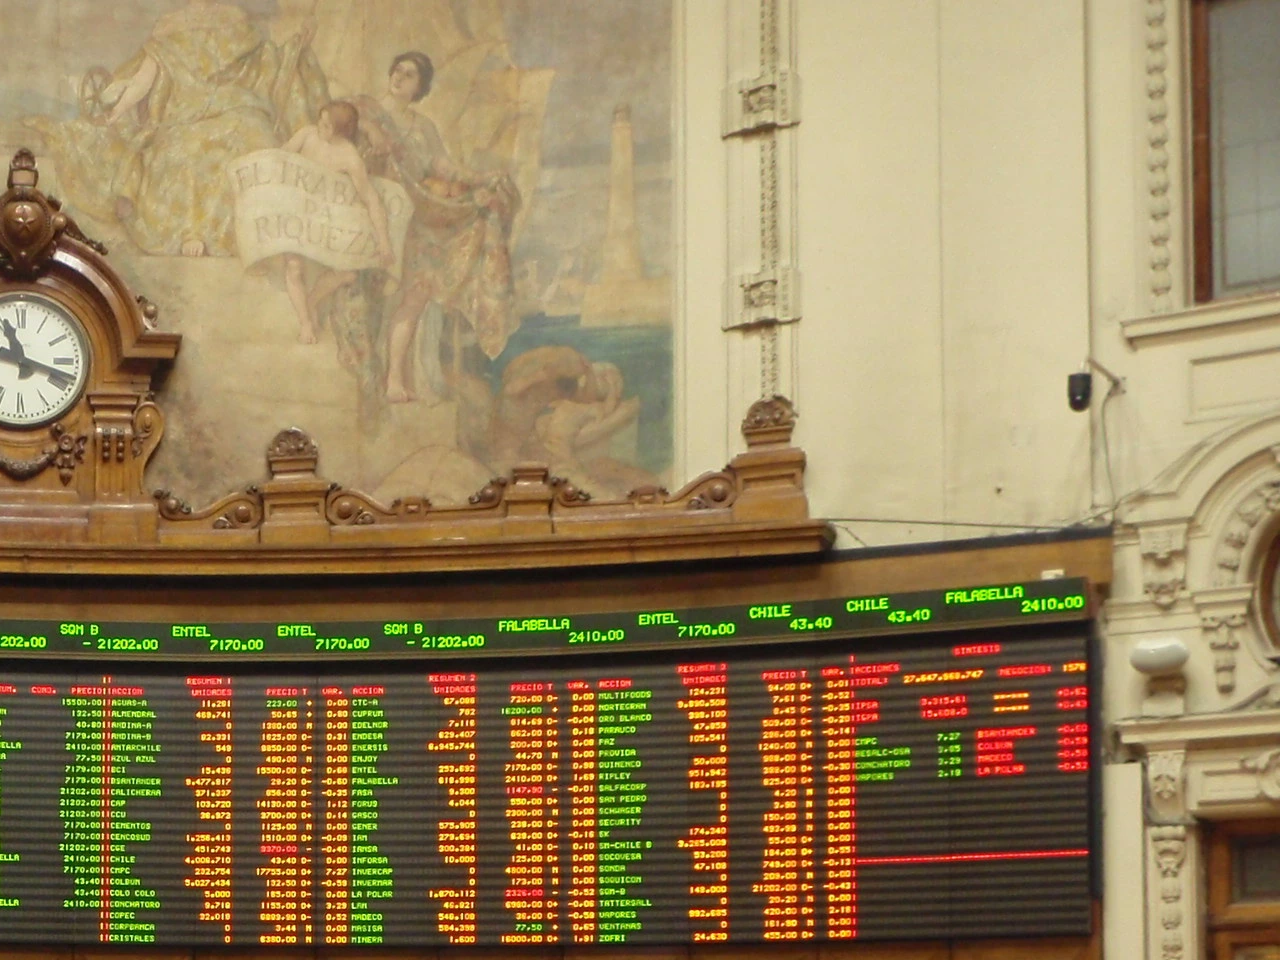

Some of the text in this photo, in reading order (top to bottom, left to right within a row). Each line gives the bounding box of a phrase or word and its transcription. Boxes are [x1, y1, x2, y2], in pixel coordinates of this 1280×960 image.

[945, 585, 1024, 604] FALABELLA
[846, 597, 889, 613] CHILE
[1021, 595, 1085, 613] 2410.00
[748, 604, 792, 619] CHILE
[887, 608, 931, 623] 43.40
[498, 618, 570, 632] FALABELLA
[638, 612, 680, 626] ENTEL
[790, 616, 833, 631] 43.40
[60, 623, 99, 636] SQM B
[172, 625, 211, 638] ENTEL
[277, 624, 317, 637] ENTEL
[383, 623, 423, 636] SQM B
[568, 629, 625, 643] 2410.00
[678, 622, 736, 638] 7170.00
[97, 638, 159, 651] 21202.00
[209, 638, 264, 651] 7170.00
[315, 637, 370, 650] 7170.00
[422, 634, 485, 648] 21202.00
